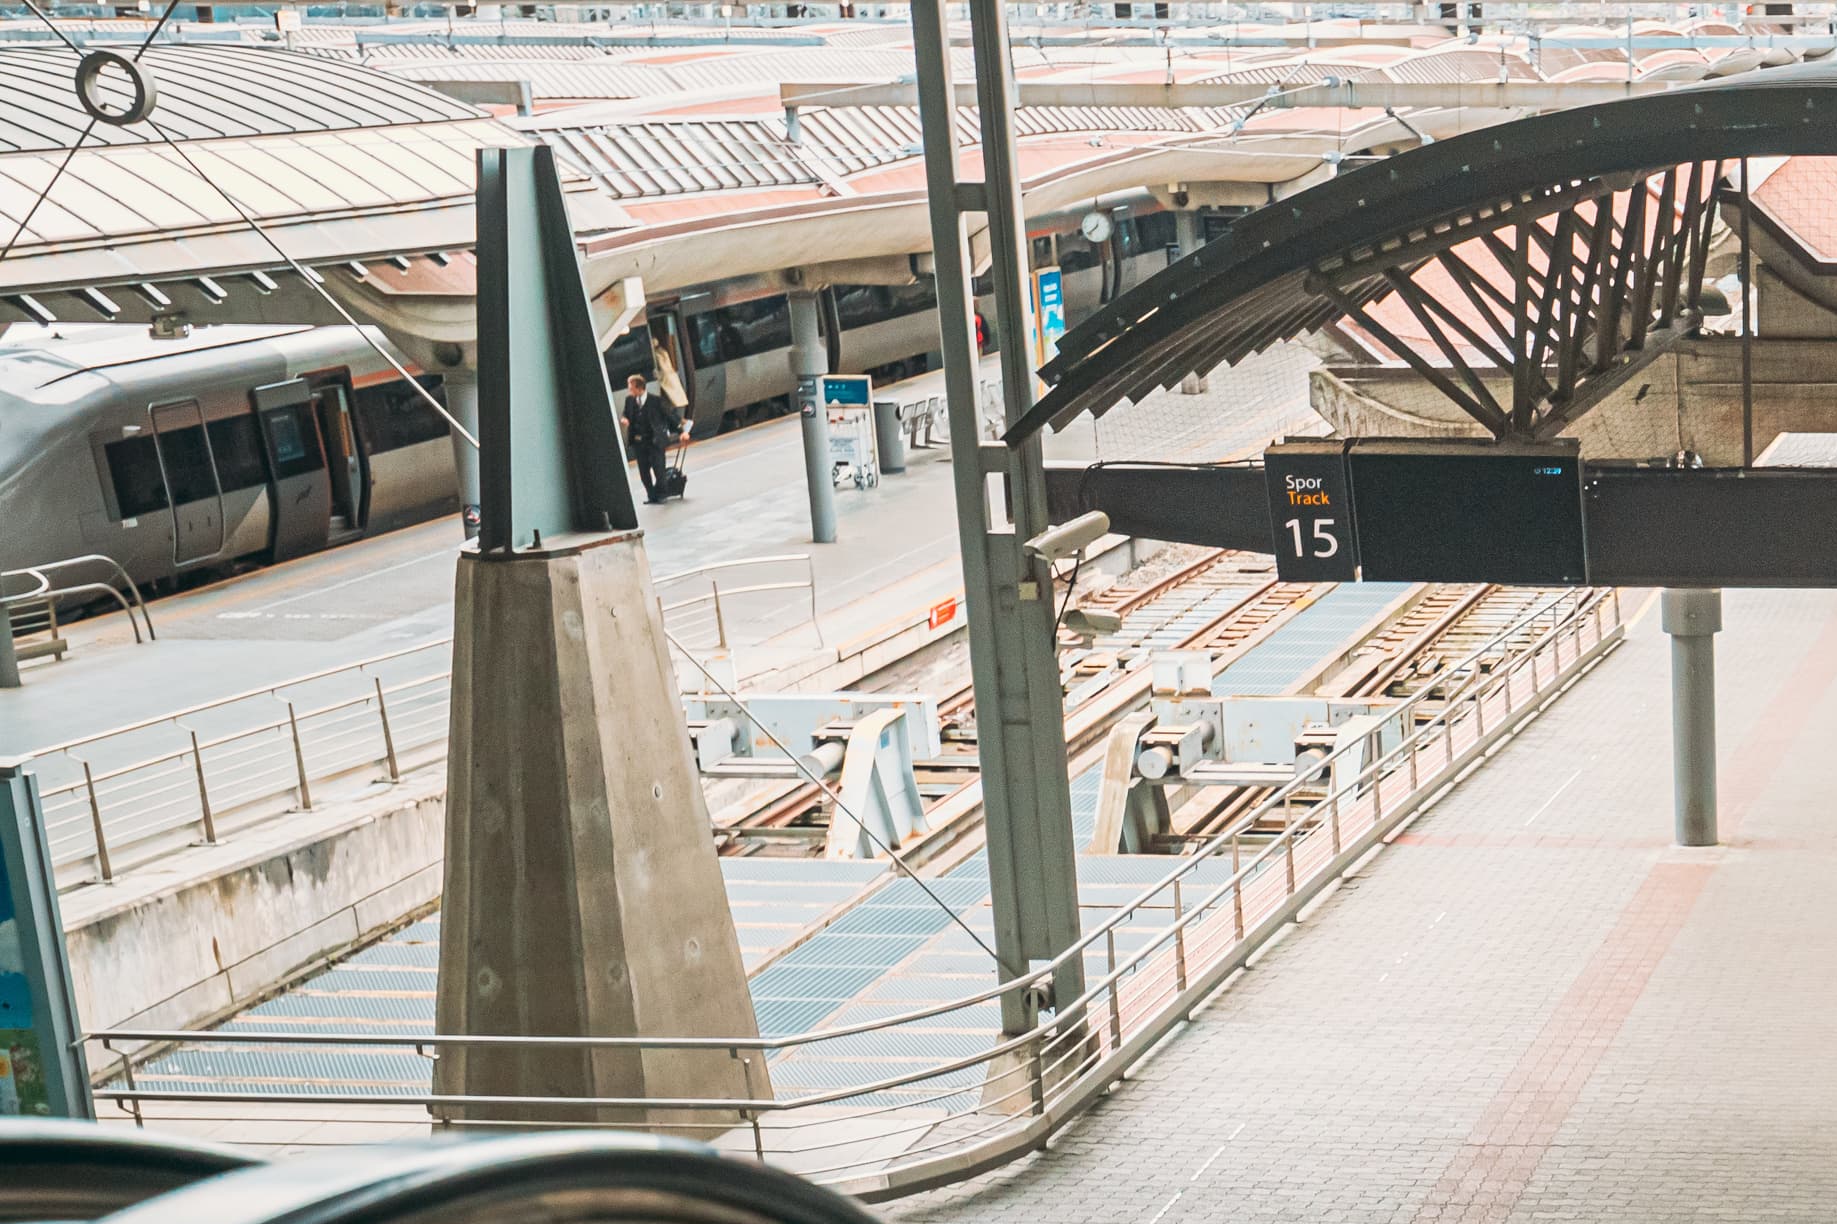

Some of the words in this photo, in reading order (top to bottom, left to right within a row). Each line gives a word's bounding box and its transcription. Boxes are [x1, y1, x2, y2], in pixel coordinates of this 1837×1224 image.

[1286, 475, 1322, 490] Spor
[1288, 491, 1330, 506] Track
[1285, 518, 1339, 559] 15
